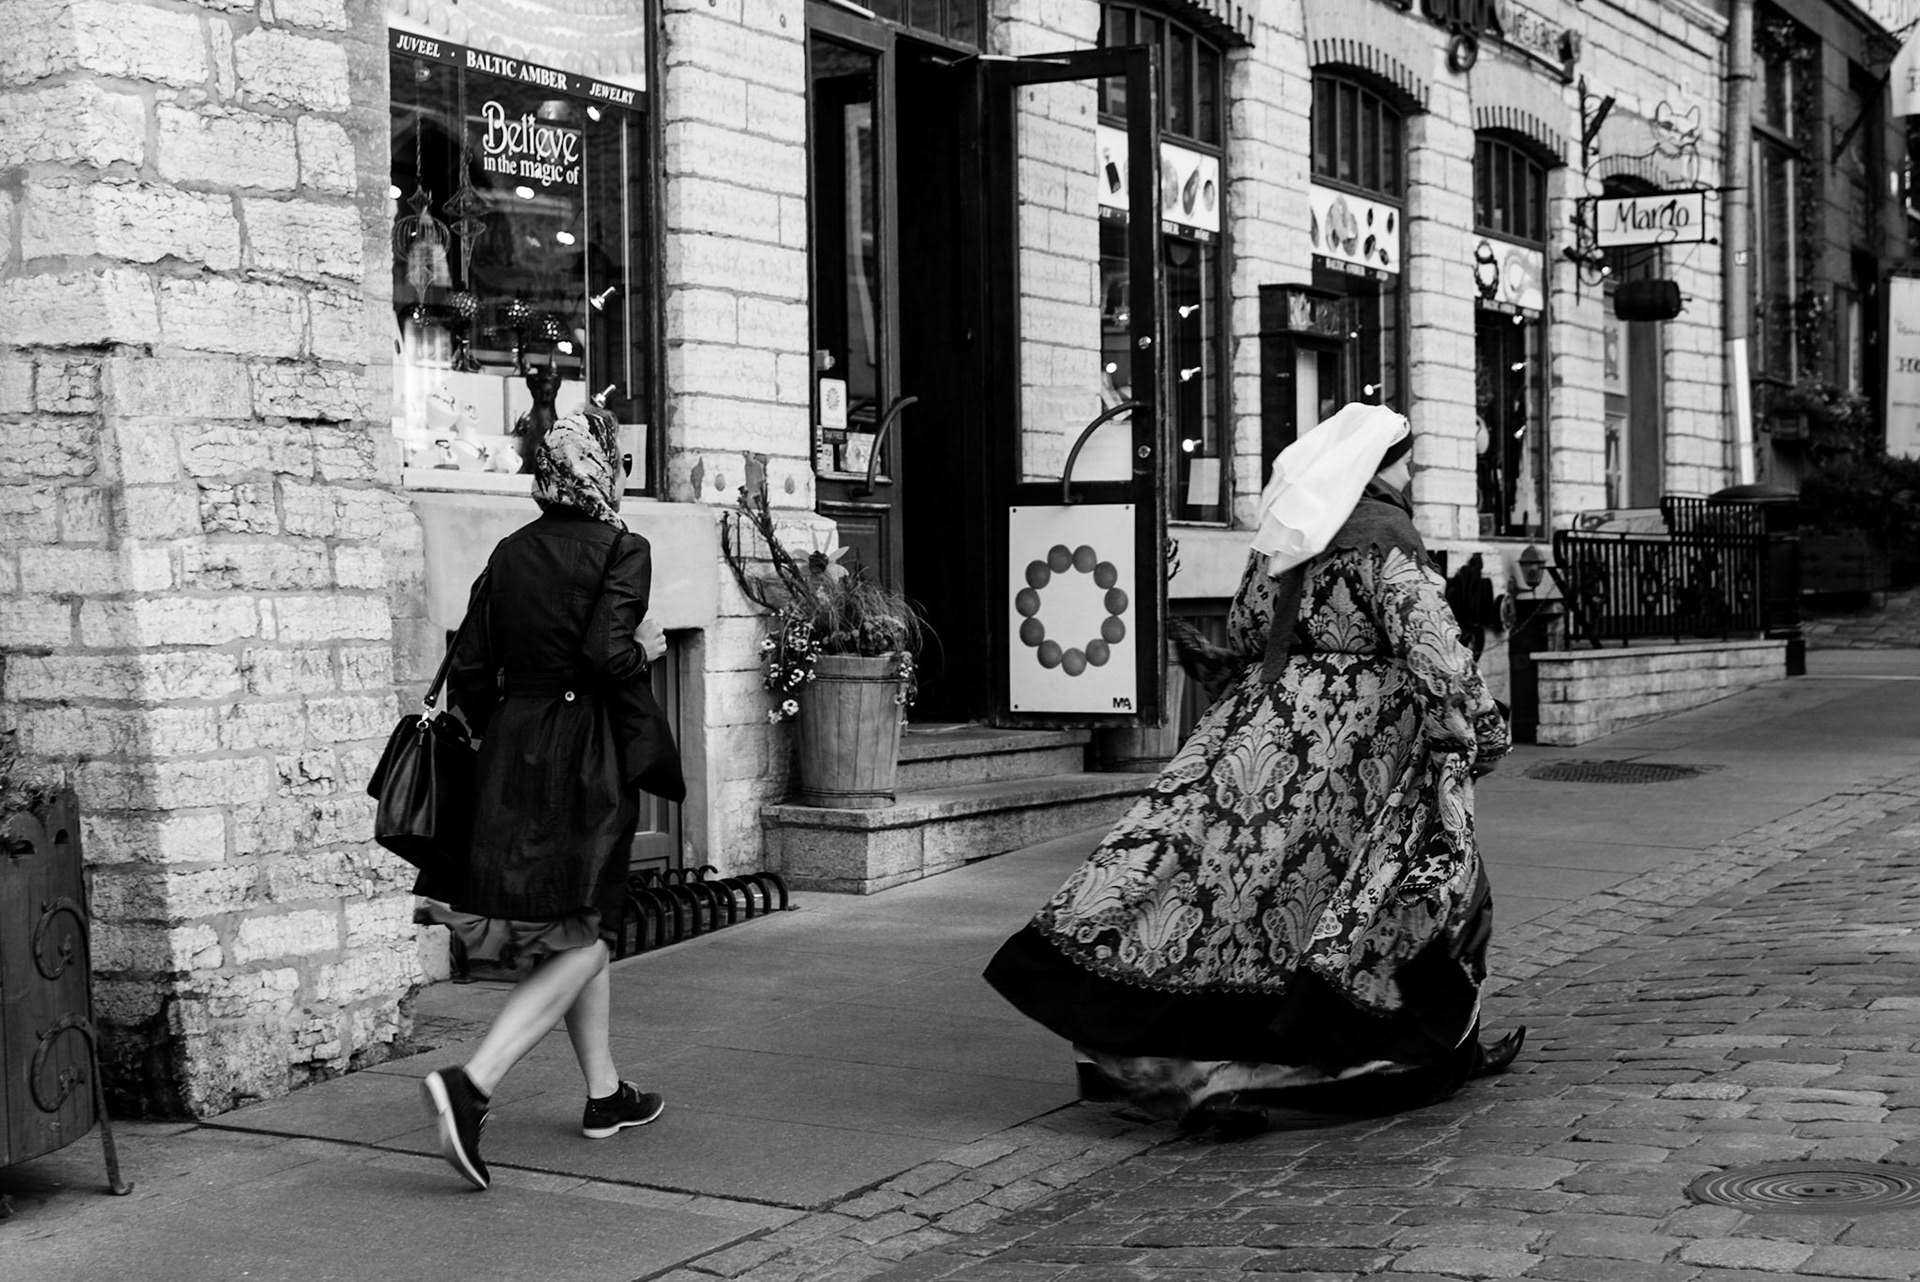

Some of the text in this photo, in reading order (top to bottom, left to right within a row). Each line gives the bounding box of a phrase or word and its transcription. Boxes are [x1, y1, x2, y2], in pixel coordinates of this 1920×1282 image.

[396, 34, 635, 105] JUVEEL BALTIC AMBER JEWELRY
[482, 100, 579, 166] Believe
[484, 150, 580, 187] in the magic of
[1612, 198, 1690, 242] Margo
